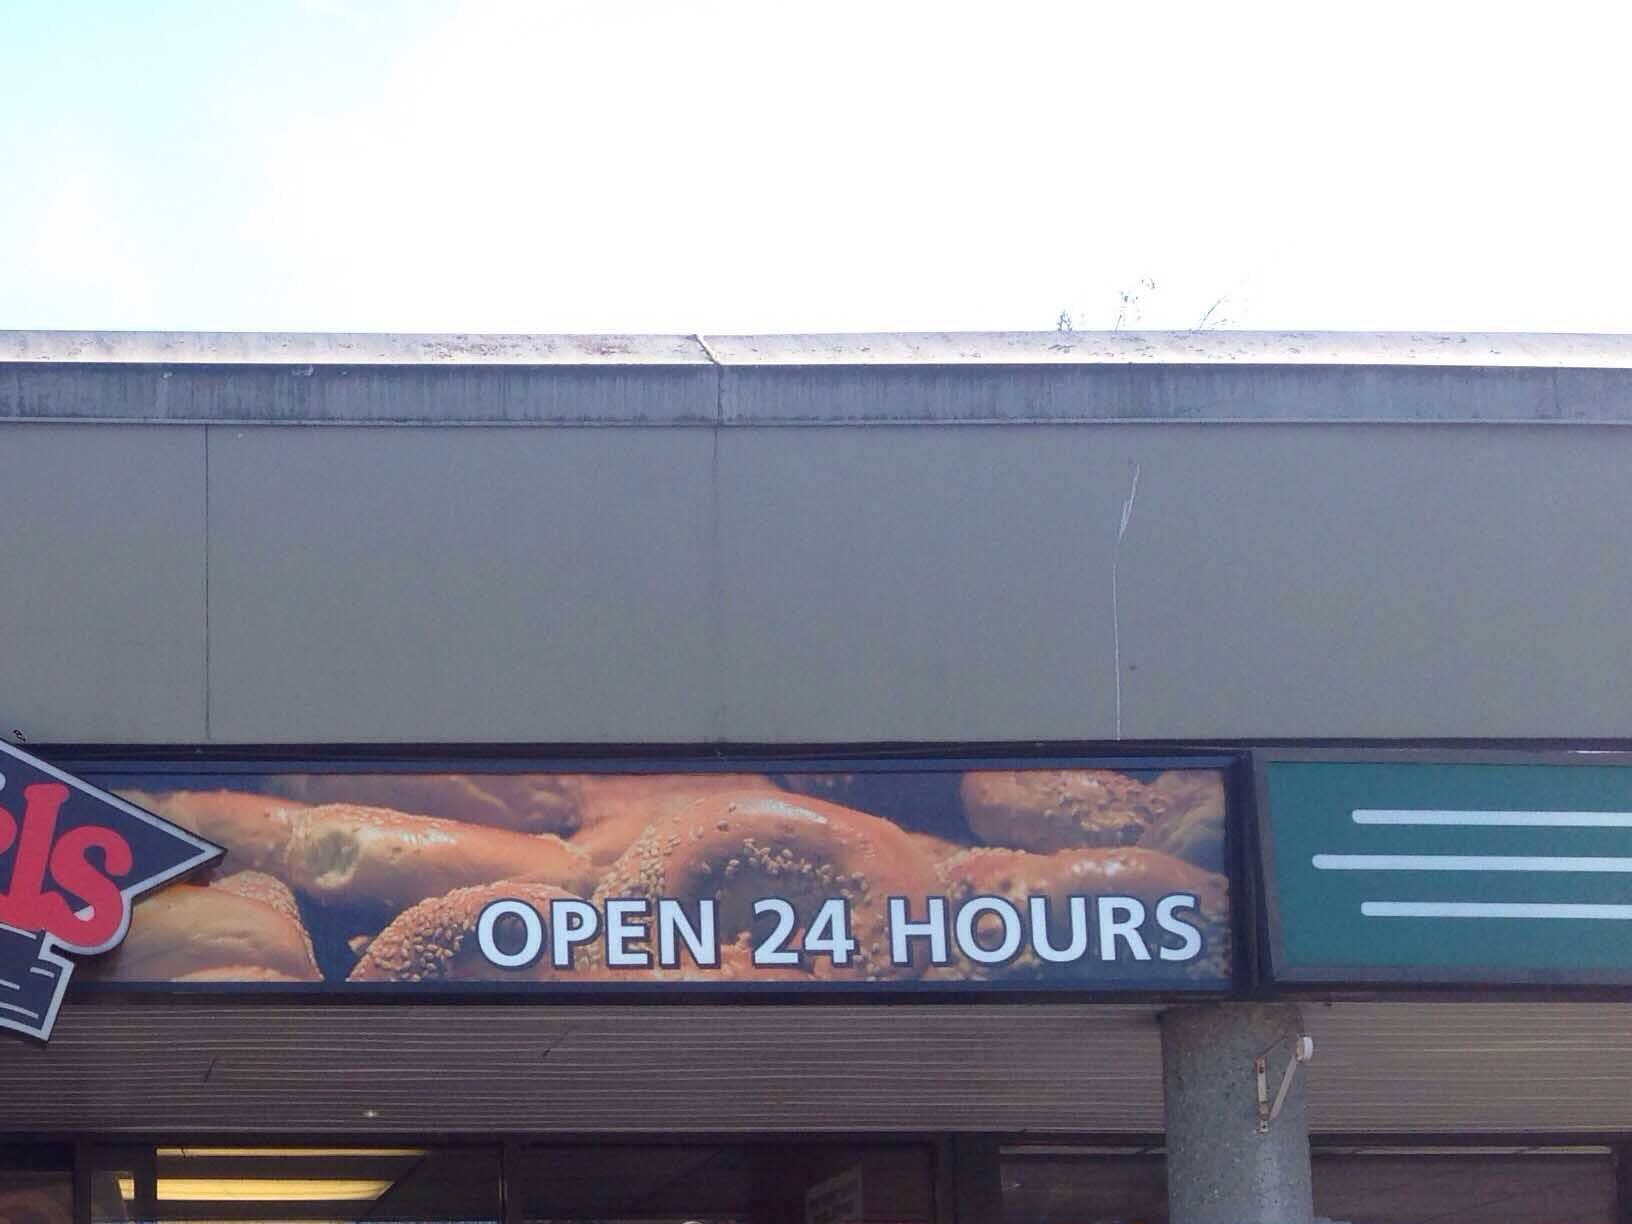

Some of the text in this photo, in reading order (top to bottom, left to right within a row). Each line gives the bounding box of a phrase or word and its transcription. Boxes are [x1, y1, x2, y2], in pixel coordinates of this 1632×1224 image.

[477, 894, 1204, 968] OPEN 24 HOURS
